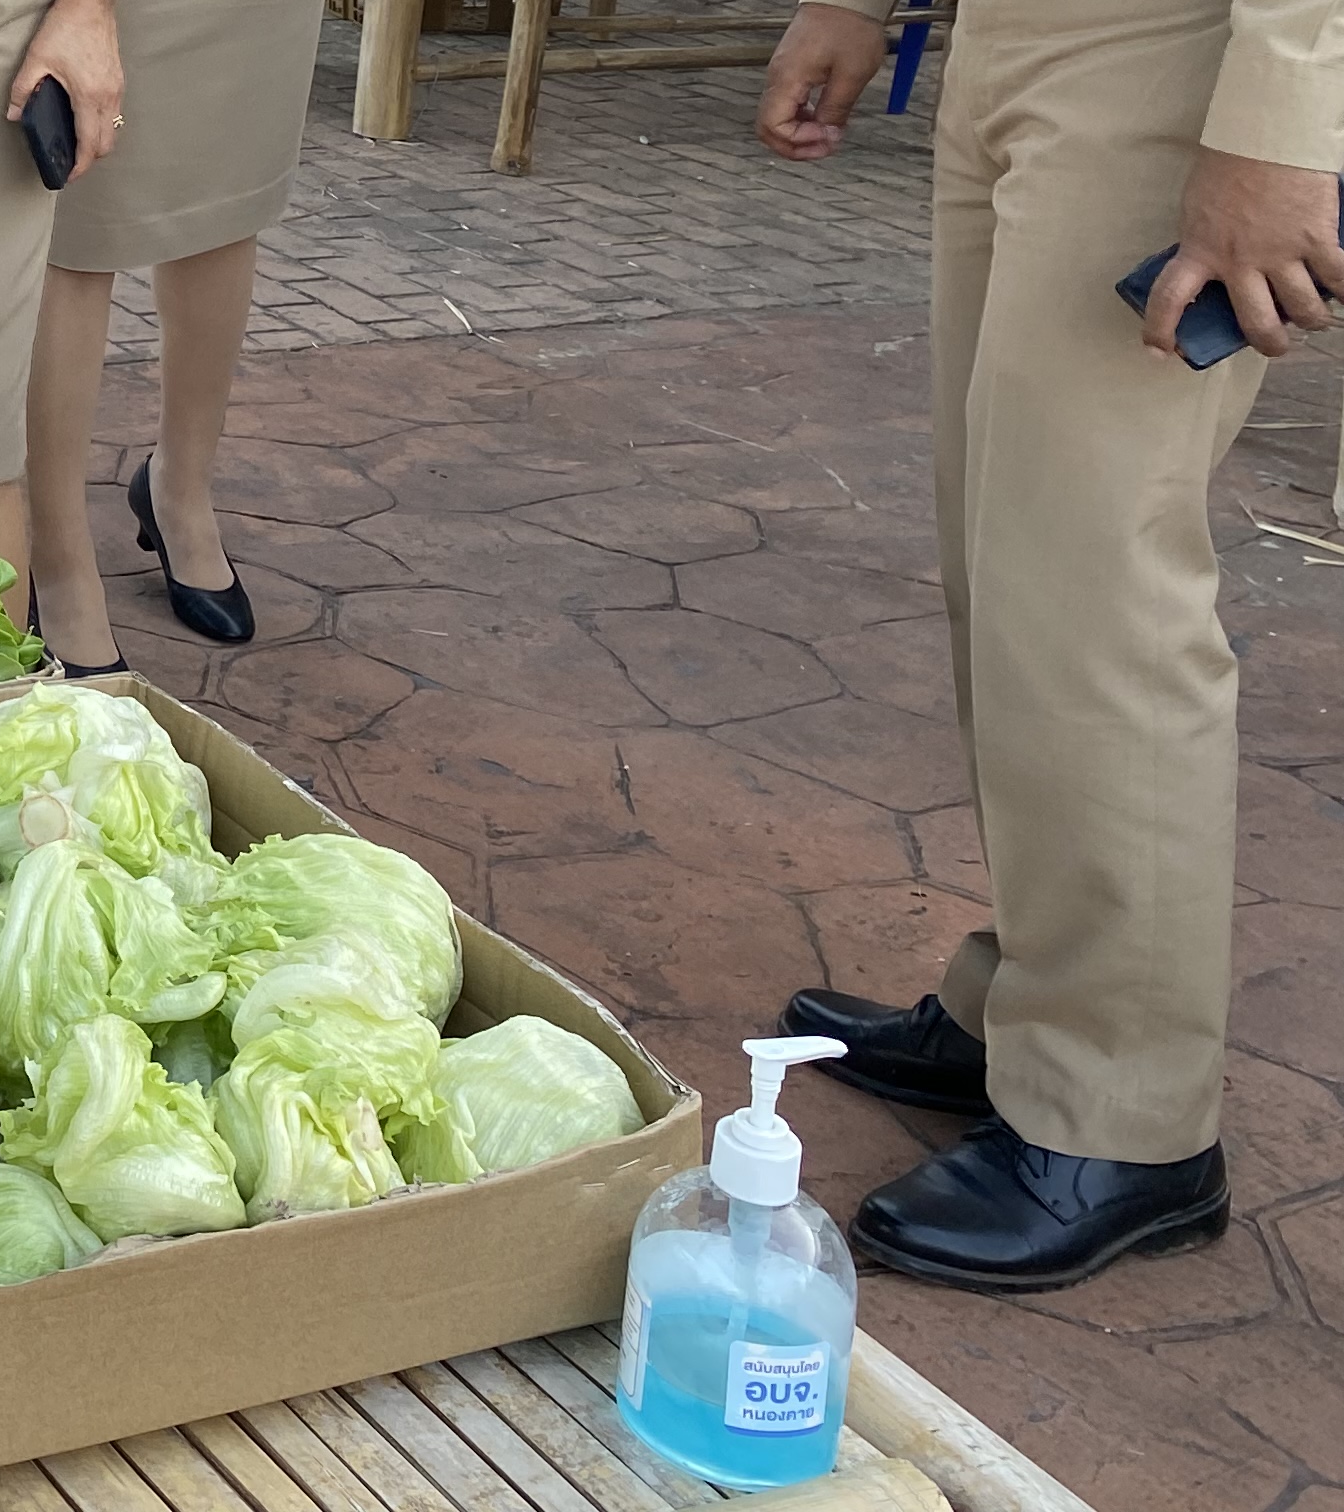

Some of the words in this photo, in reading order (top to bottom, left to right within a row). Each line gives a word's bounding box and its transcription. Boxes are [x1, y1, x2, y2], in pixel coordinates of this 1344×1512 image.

[744, 1381, 818, 1404] อบจ.
[742, 1407, 815, 1422] หนองคาย
